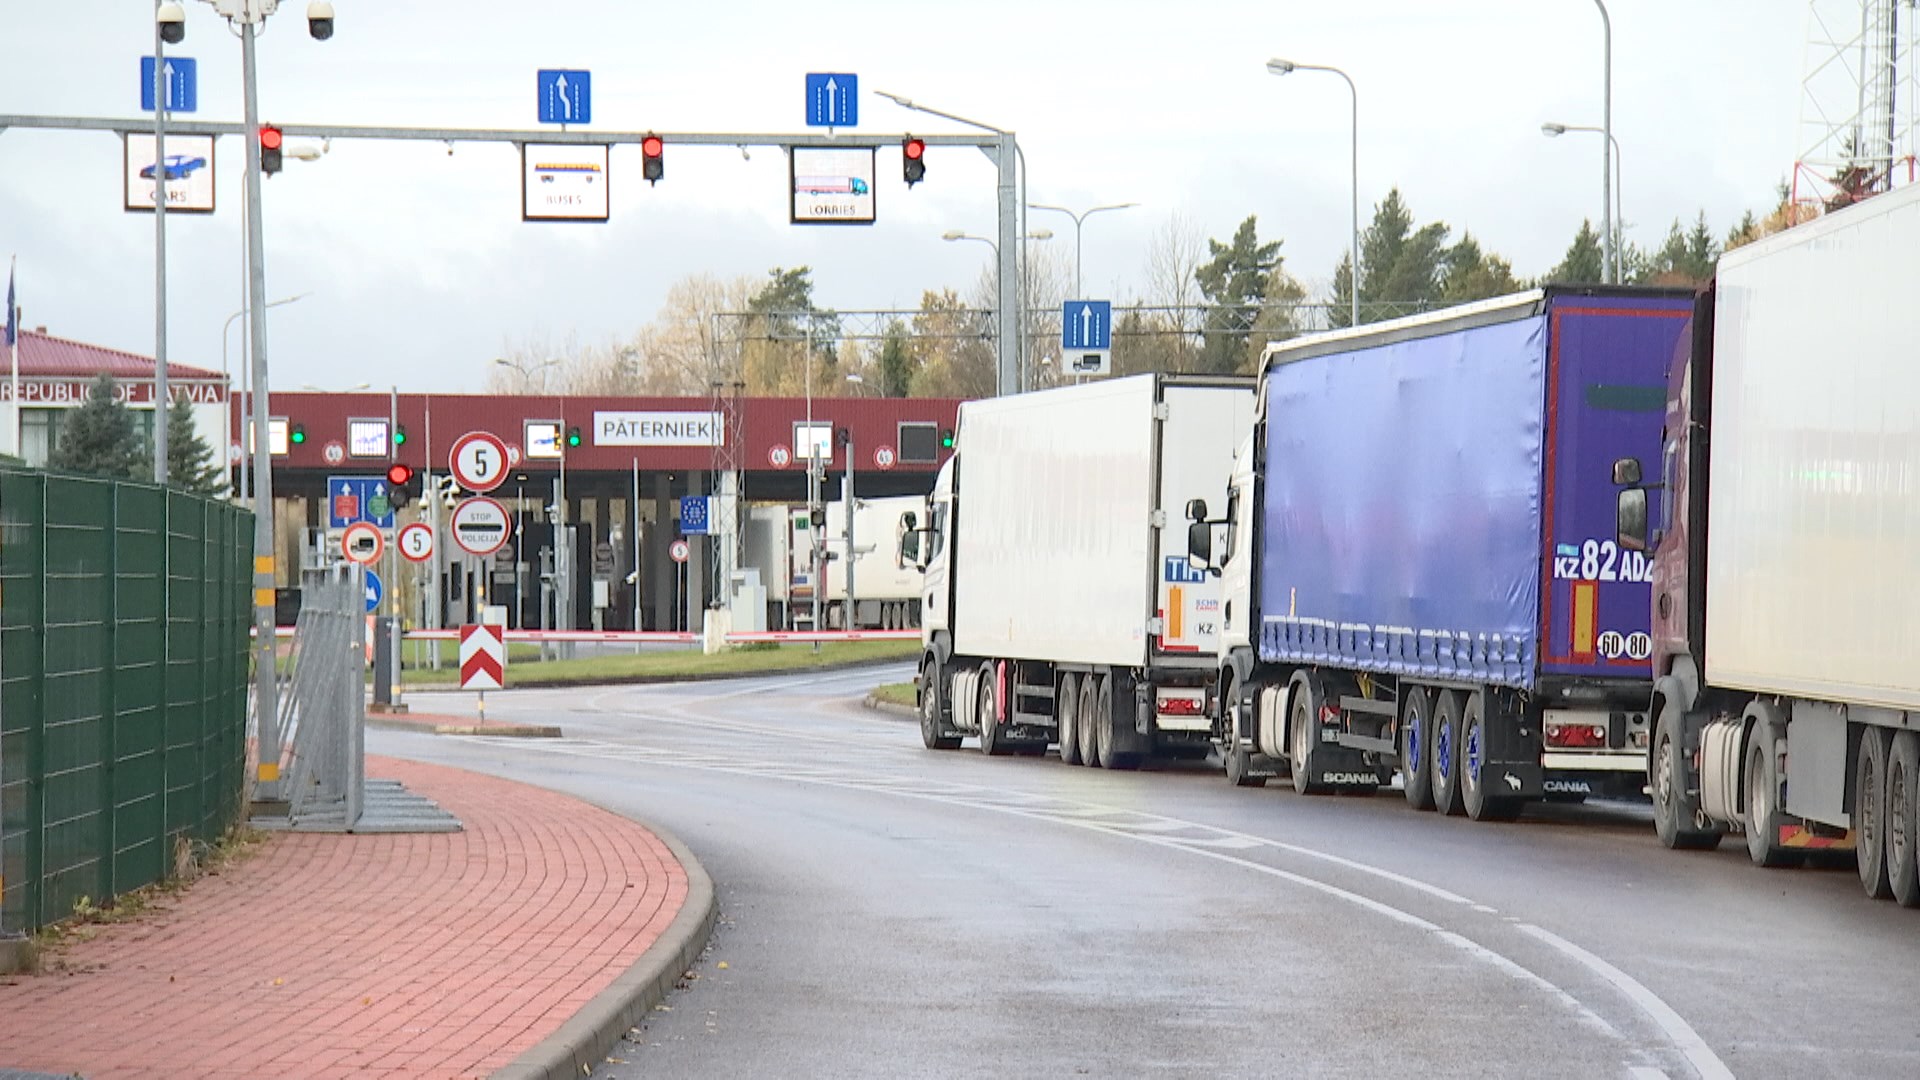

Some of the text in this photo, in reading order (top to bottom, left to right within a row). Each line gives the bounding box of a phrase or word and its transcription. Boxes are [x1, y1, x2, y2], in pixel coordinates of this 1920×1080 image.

[809, 204, 856, 216] LORRIES
[475, 449, 487, 477] 5
[470, 513, 492, 522] STOP
[413, 532, 422, 552] 5
[461, 534, 499, 543] POLICIJA
[1554, 557, 1579, 578] KZ
[1582, 539, 1617, 581] 82
[1198, 623, 1213, 634] KZ
[1602, 634, 1620, 656] 60
[1630, 634, 1648, 656] 80
[1322, 770, 1380, 785] SCANIA
[1543, 780, 1592, 793] CANIA
